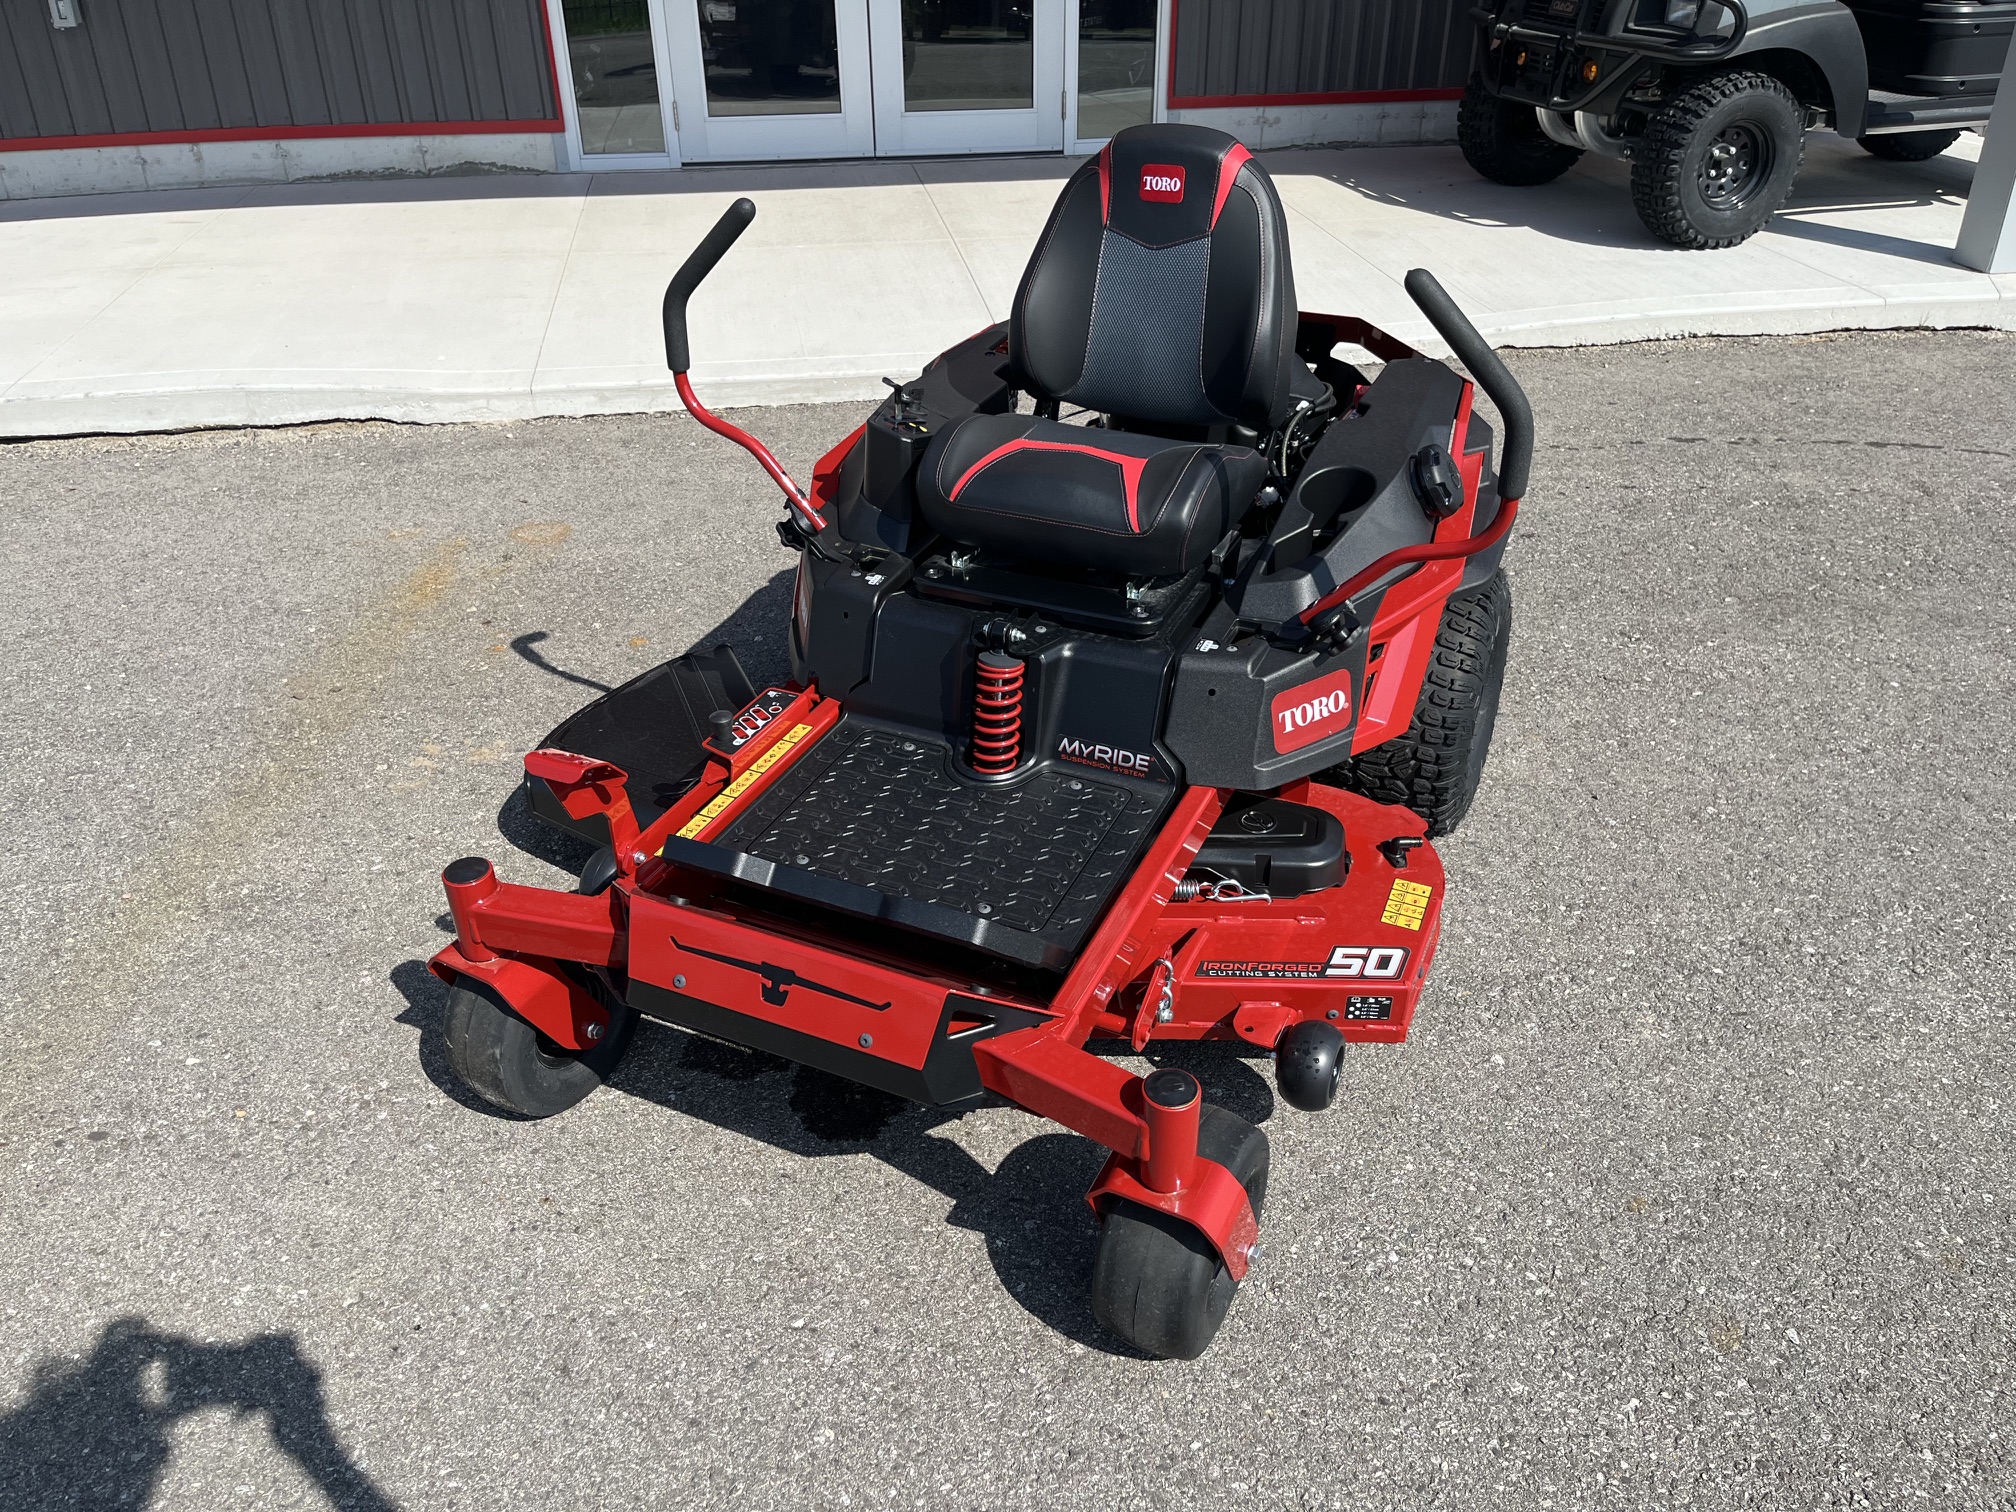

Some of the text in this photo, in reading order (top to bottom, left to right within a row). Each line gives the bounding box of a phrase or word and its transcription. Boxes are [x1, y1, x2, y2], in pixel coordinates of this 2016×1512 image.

[1143, 176, 1181, 192] TORO
[1278, 690, 1346, 734] TORO
[1061, 754, 1146, 779] SUSPENSION SYSTEM
[1325, 947, 1405, 977] 50
